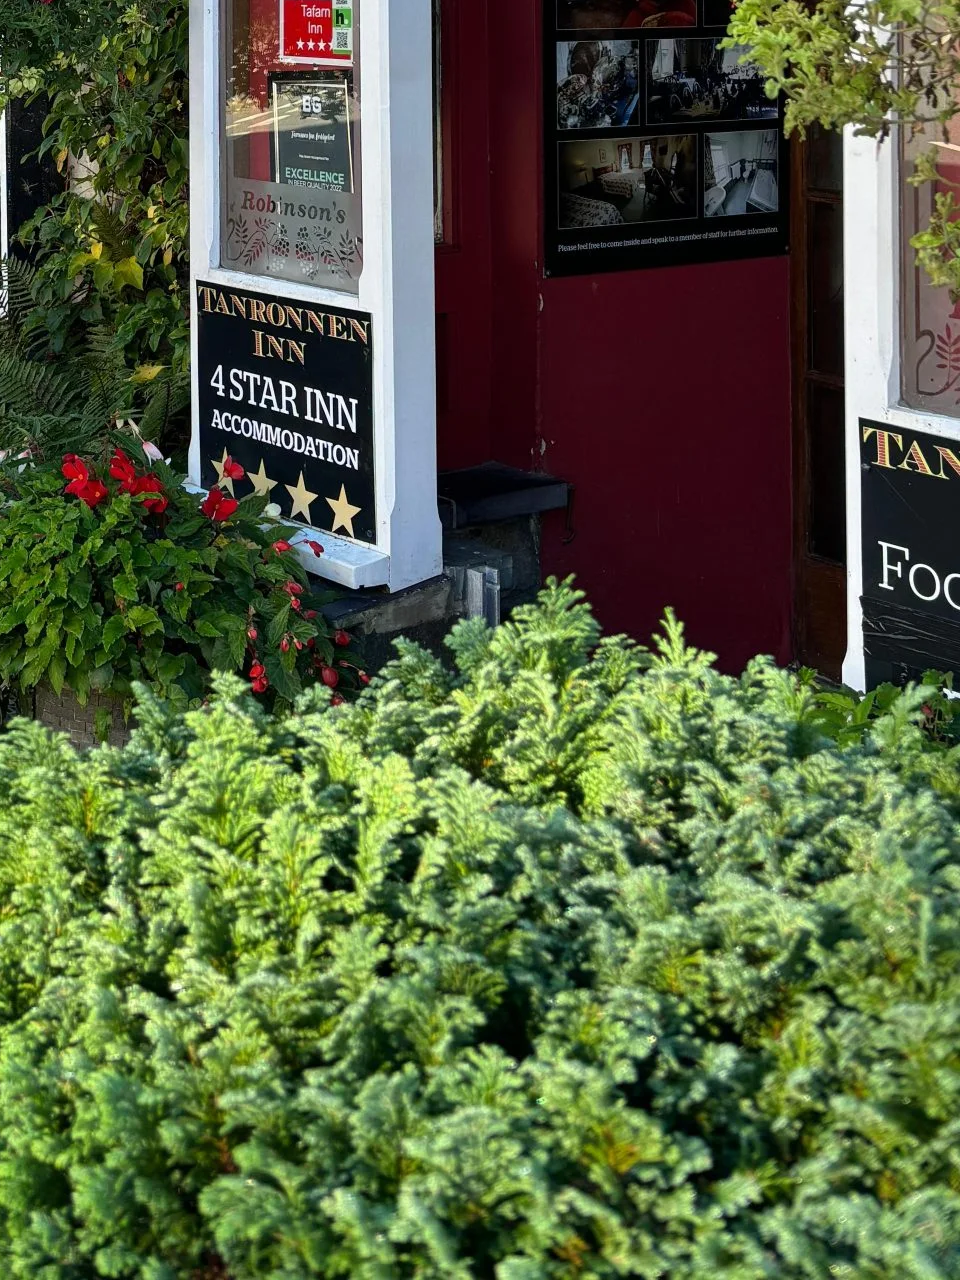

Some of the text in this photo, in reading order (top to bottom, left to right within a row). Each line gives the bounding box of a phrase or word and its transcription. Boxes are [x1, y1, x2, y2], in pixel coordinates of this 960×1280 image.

[301, 5, 331, 18] Tafarn
[308, 22, 322, 34] Inn
[285, 167, 344, 184] EXCELLENCE
[307, 182, 329, 190] QUALITY
[330, 184, 342, 192] 2022
[242, 191, 347, 224] Robinson's
[558, 244, 577, 252] Please
[578, 243, 589, 251] feel
[623, 239, 641, 247] inside
[652, 236, 669, 245] speak
[708, 231, 720, 239] staff
[728, 229, 747, 237] further
[198, 286, 370, 345] TANRONNEN
[251, 329, 306, 365] INN
[210, 365, 358, 433] 4 STAR INN
[211, 409, 359, 471] ACCOMMODATION
